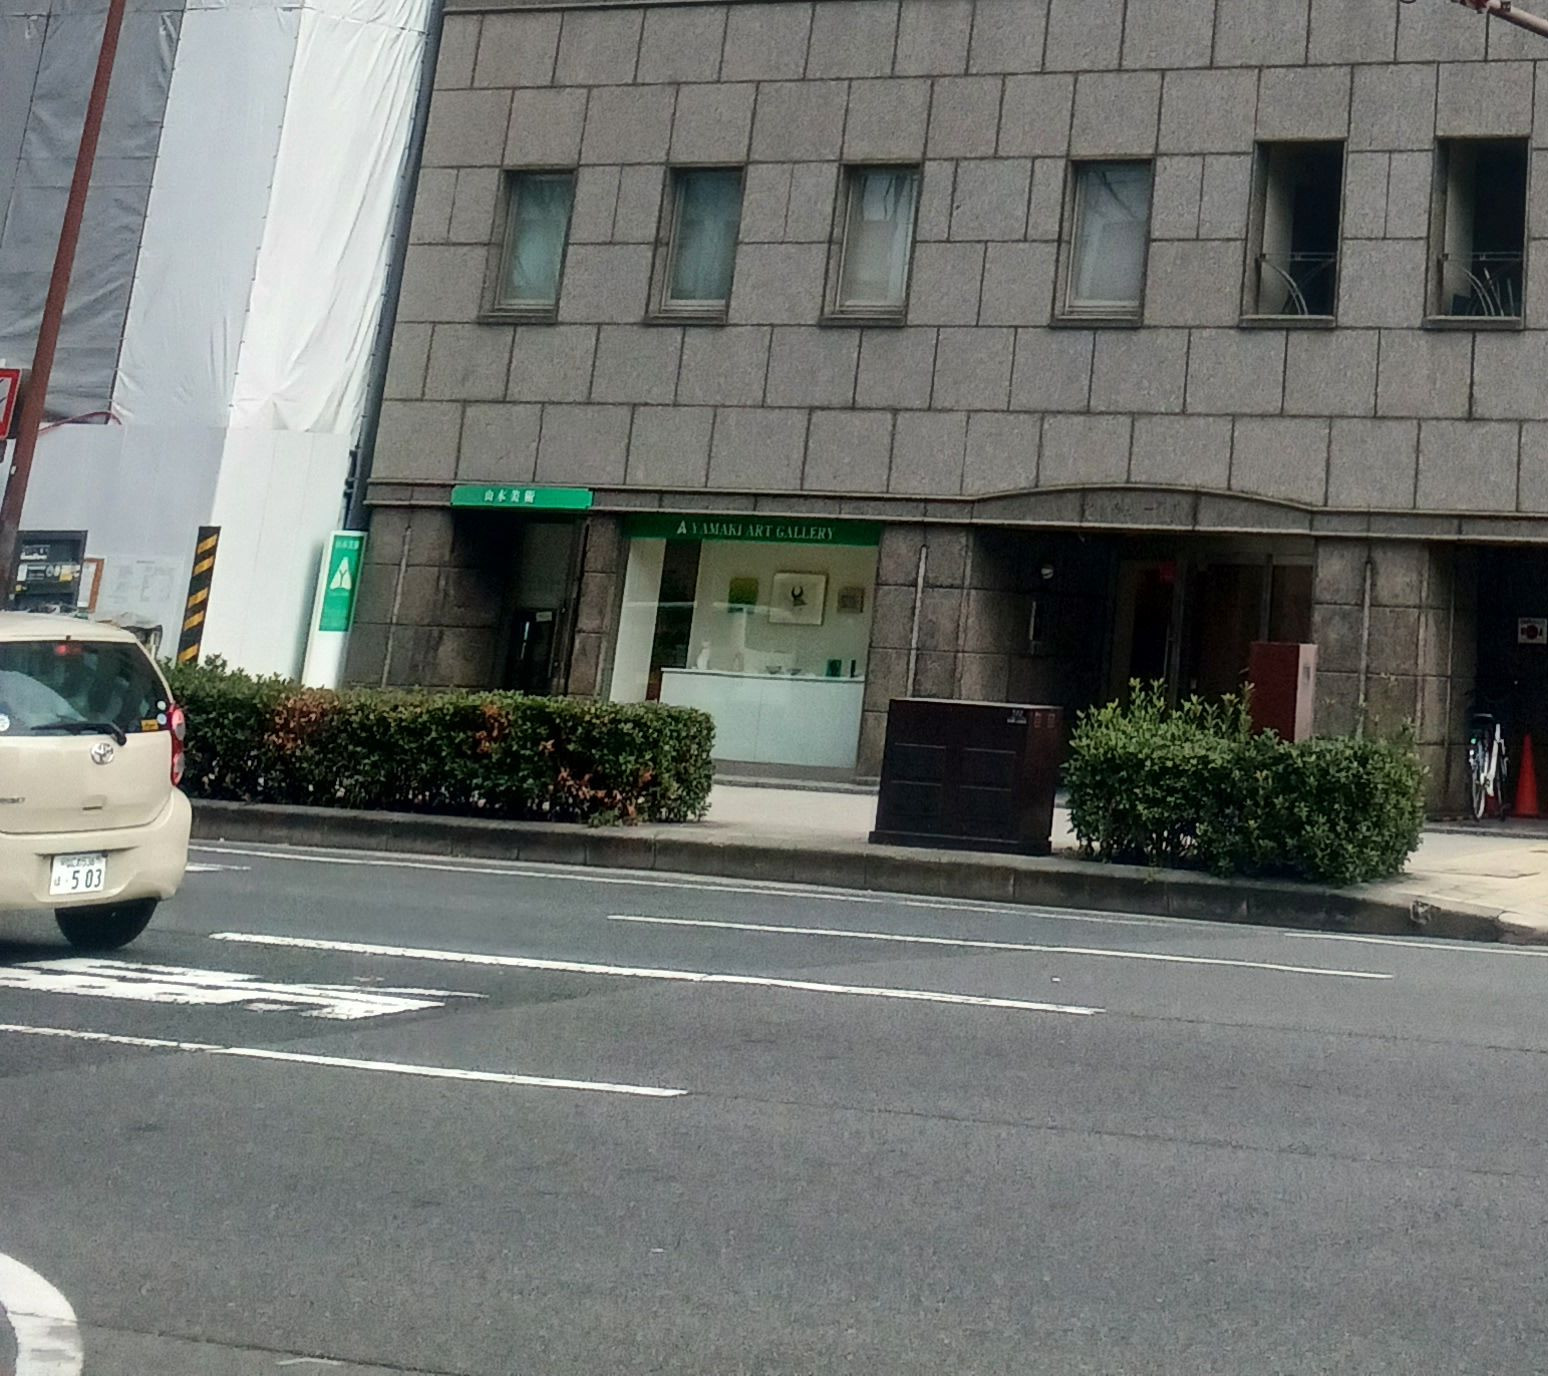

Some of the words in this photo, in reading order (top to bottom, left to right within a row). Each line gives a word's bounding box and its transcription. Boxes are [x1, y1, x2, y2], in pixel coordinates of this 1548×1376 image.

[692, 522, 743, 537] YAMAKI
[749, 524, 773, 538] ART
[776, 526, 834, 541] GALLERY
